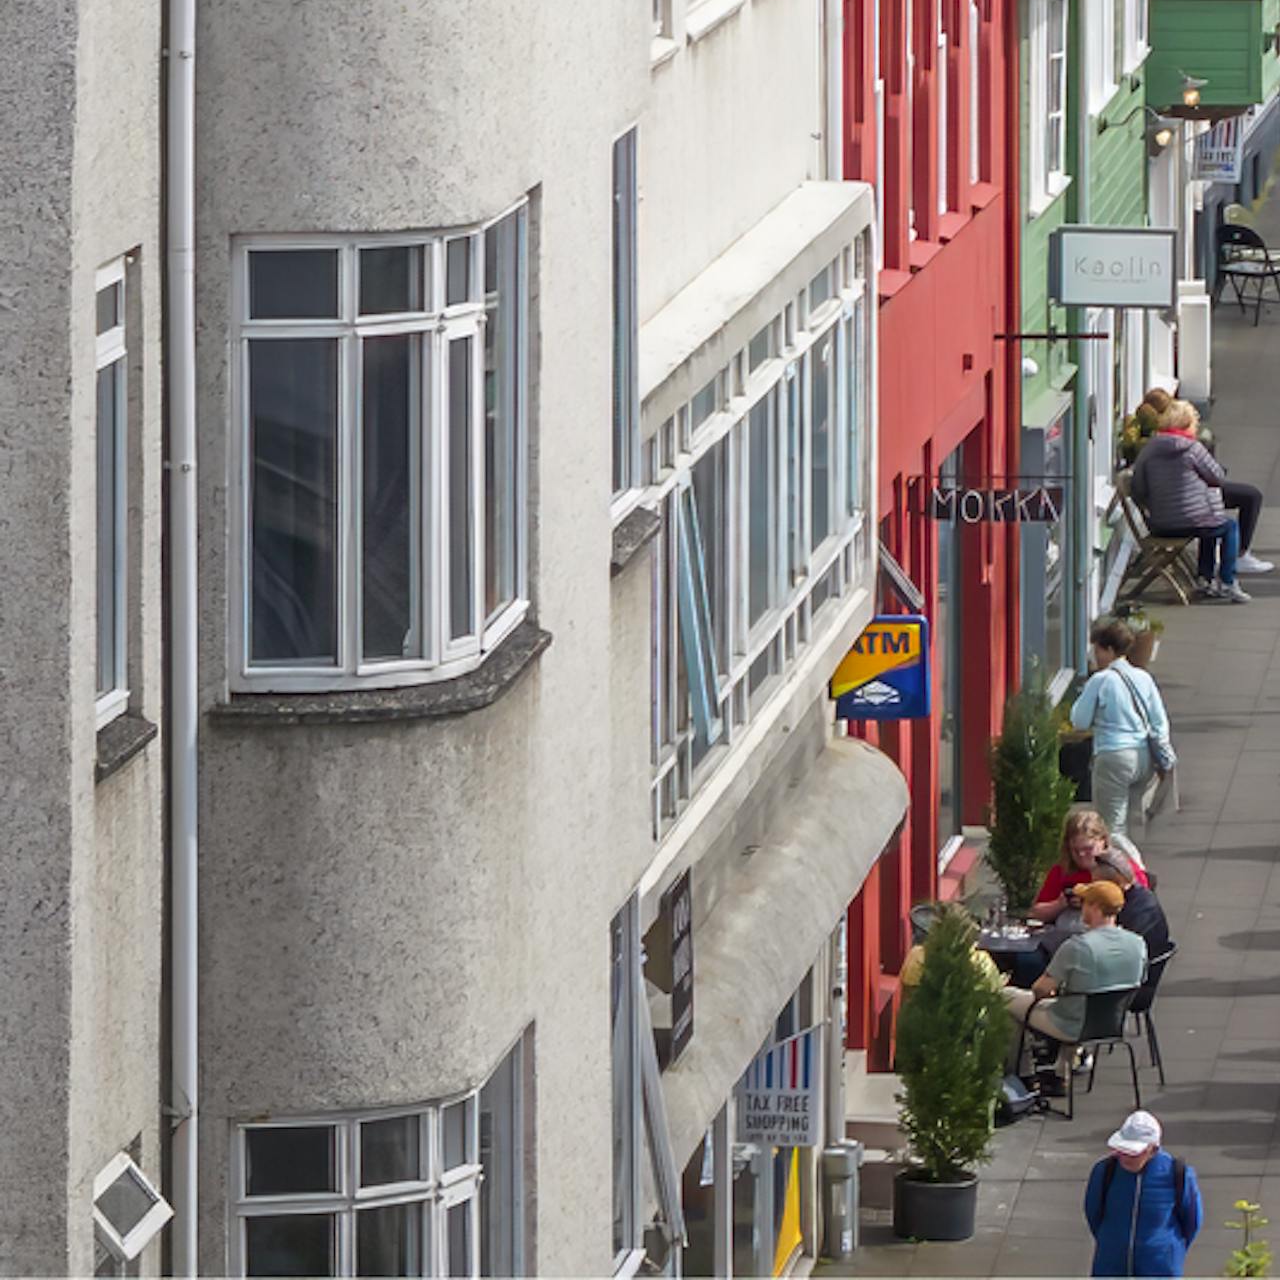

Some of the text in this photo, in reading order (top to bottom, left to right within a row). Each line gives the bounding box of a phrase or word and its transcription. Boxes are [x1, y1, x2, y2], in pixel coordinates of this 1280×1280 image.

[1073, 255, 1163, 277] Kaolin
[746, 1094, 810, 1113] TAX FREE
[745, 1114, 810, 1132] SHOPPING
